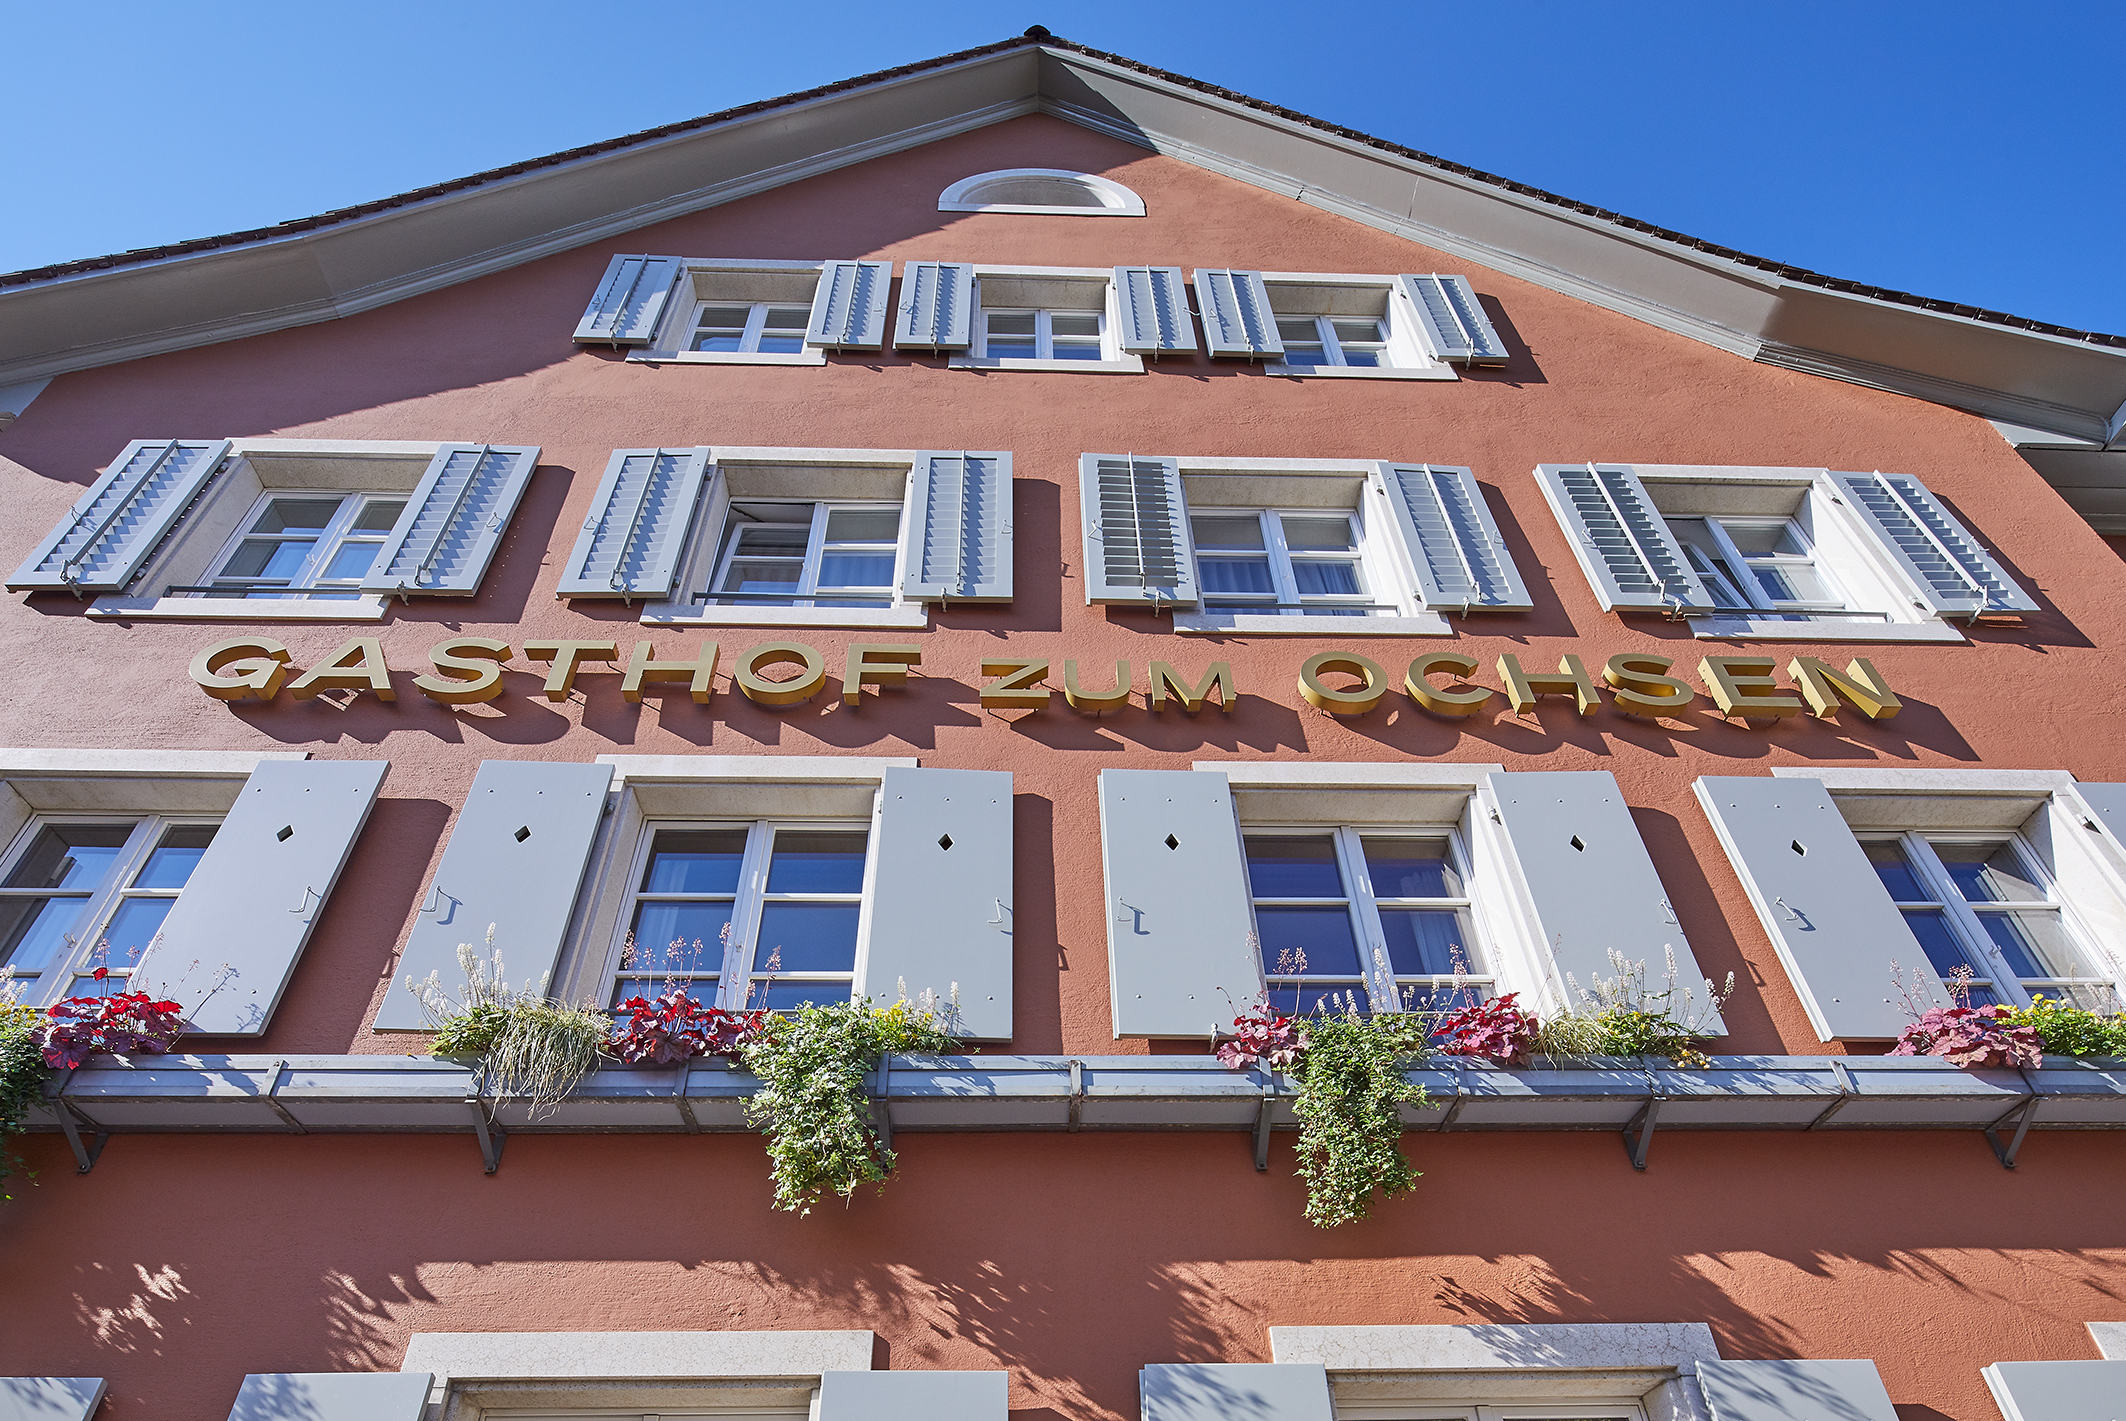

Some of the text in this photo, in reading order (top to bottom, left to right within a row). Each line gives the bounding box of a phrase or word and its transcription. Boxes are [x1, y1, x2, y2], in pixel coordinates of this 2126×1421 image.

[188, 636, 1904, 719] GASTHOF ZUM OCHSEN
